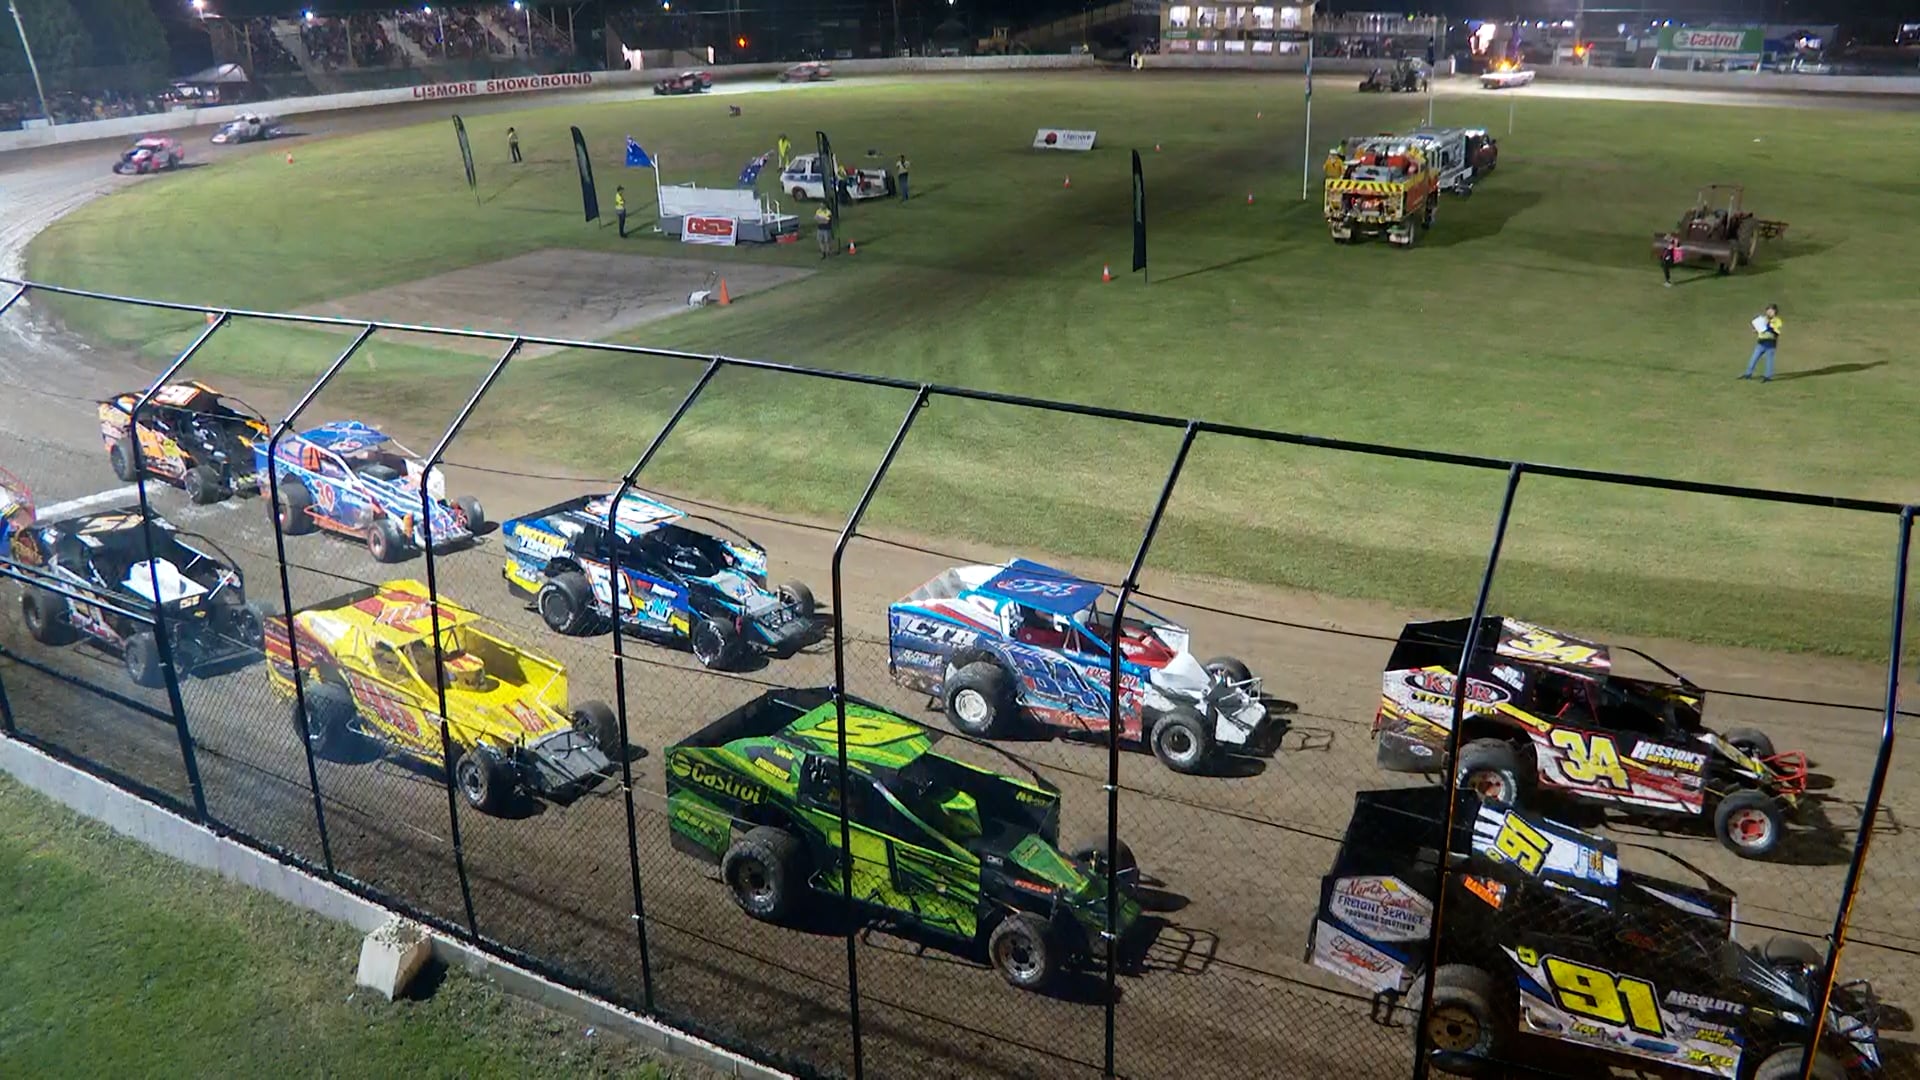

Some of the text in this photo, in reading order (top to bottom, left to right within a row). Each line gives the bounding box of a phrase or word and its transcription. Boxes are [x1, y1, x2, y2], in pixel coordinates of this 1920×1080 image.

[1689, 33, 1740, 48] Castrol
[413, 72, 592, 99] LISMORE SHOWGROUND
[1507, 632, 1598, 664] 34
[1550, 728, 1631, 790] 34
[1337, 895, 1426, 926] FREIGHT SERVICE
[1380, 916, 1416, 932] SOLUTIONS
[1546, 958, 1665, 1034] 91
[1665, 990, 1744, 1015] ABSOLUTE
